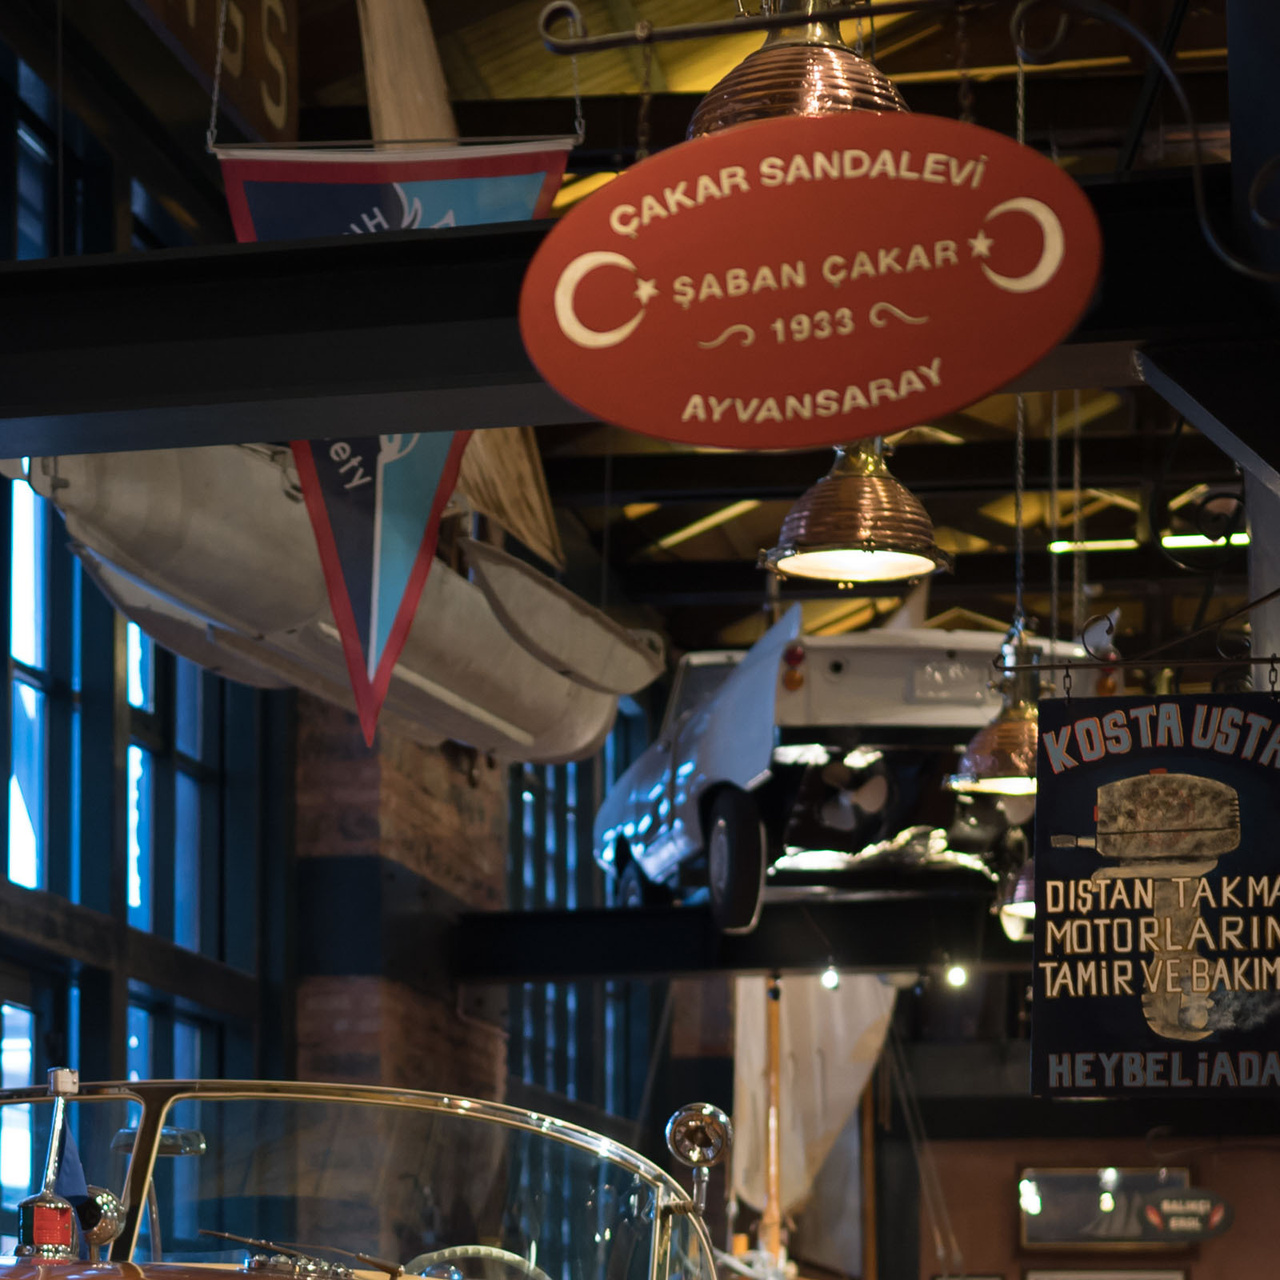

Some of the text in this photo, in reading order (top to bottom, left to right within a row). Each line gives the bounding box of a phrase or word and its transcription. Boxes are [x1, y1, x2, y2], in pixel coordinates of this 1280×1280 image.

[609, 166, 751, 239] ÇAKAR
[672, 240, 960, 309] ŞABAN ÇAKAR
[771, 306, 856, 344] 1933
[680, 356, 942, 424] AYVANSARAY
[1042, 703, 1184, 775] KOSTA
[1046, 878, 1154, 914] DIŞTAN
[1140, 958, 1184, 994] VE
